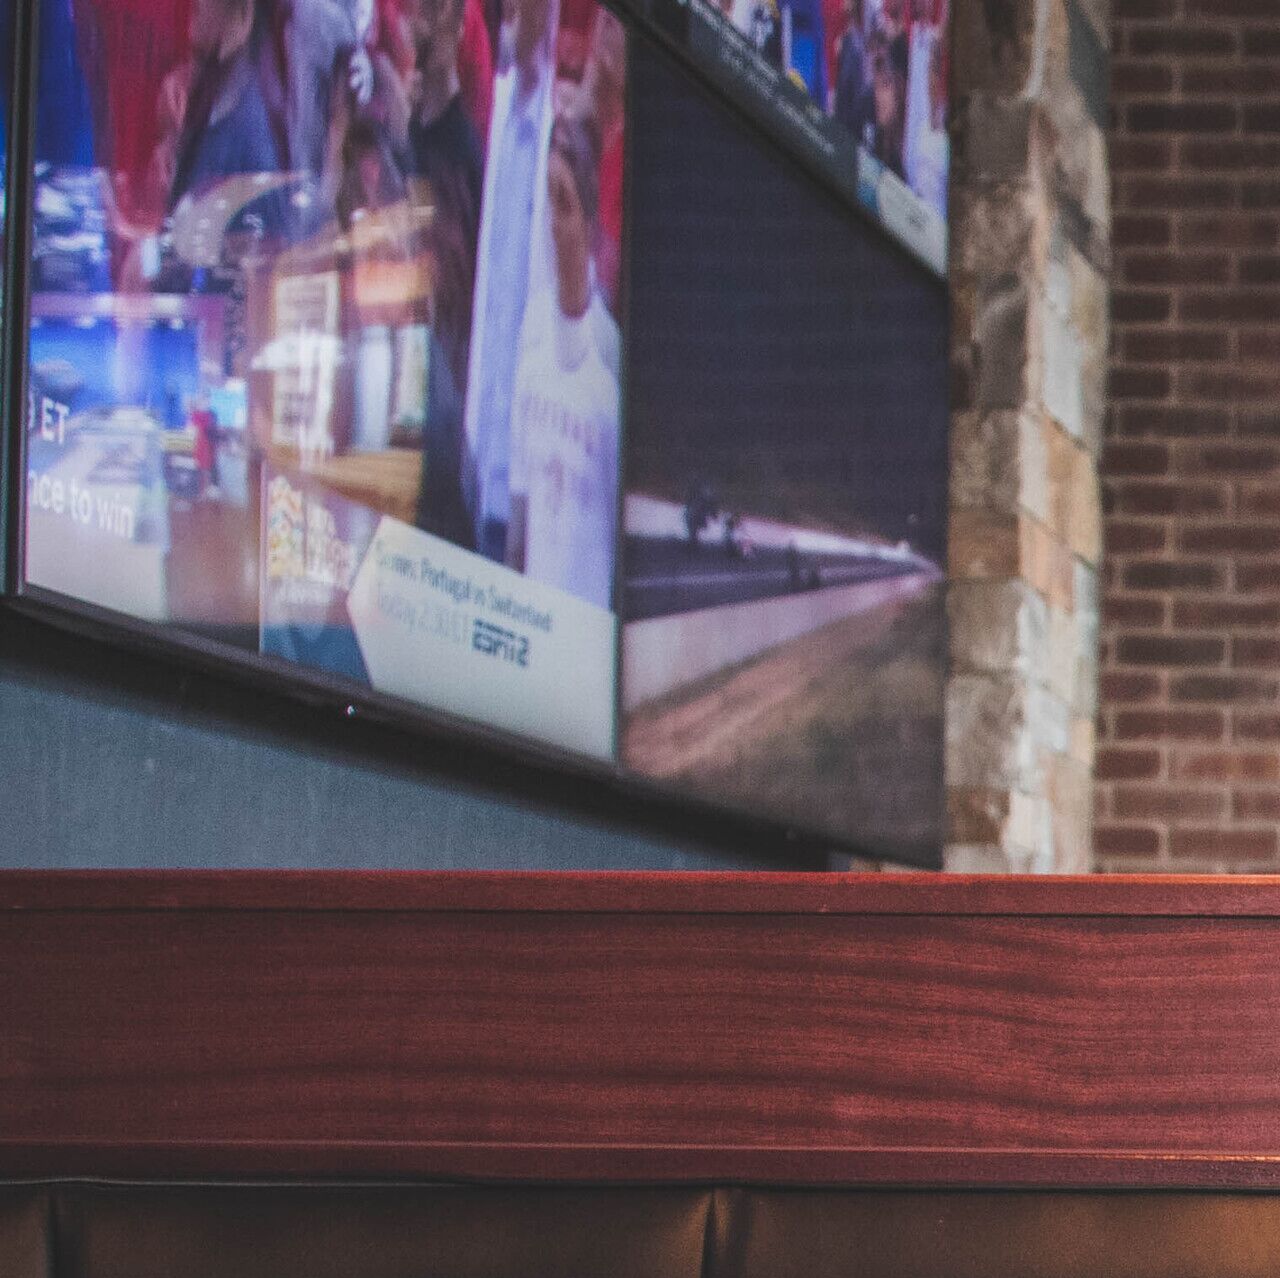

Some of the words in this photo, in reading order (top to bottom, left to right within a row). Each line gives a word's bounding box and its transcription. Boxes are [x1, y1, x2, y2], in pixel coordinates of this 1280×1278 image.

[42, 397, 70, 444] ET
[70, 476, 92, 524] to
[97, 492, 135, 539] win
[420, 557, 472, 604] Portugal
[472, 617, 529, 668] ESPN2
